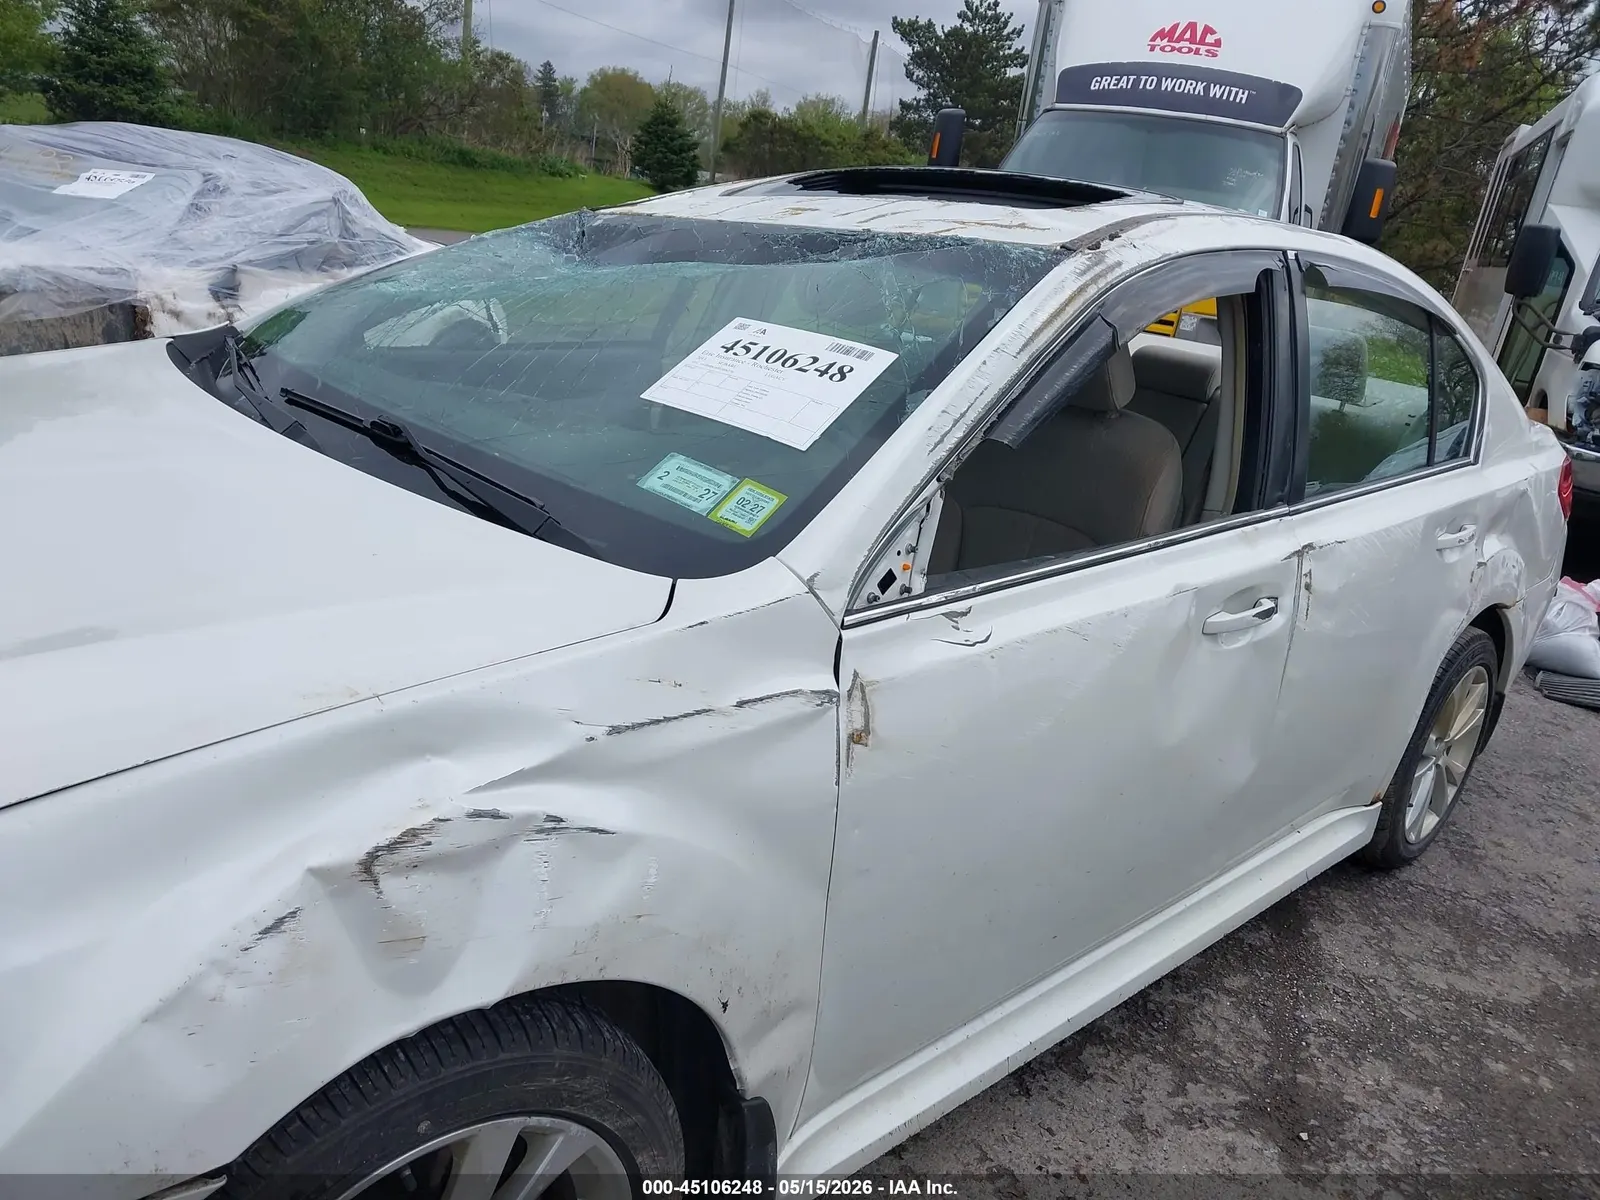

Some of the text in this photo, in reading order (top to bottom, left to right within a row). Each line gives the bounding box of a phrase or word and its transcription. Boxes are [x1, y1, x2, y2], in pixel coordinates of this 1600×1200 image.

[1148, 21, 1222, 48] MAC
[1147, 44, 1219, 58] TOOLS
[1090, 75, 1137, 91] GREAT
[1139, 75, 1158, 90] TO
[1160, 77, 1206, 97] WORK
[716, 352, 746, 364] Insurance
[751, 361, 783, 374] Rochester
[721, 338, 854, 383] 45106248
[657, 471, 670, 480] 2
[698, 488, 719, 501] 27
[736, 496, 751, 508] 02
[750, 503, 766, 514] 27
